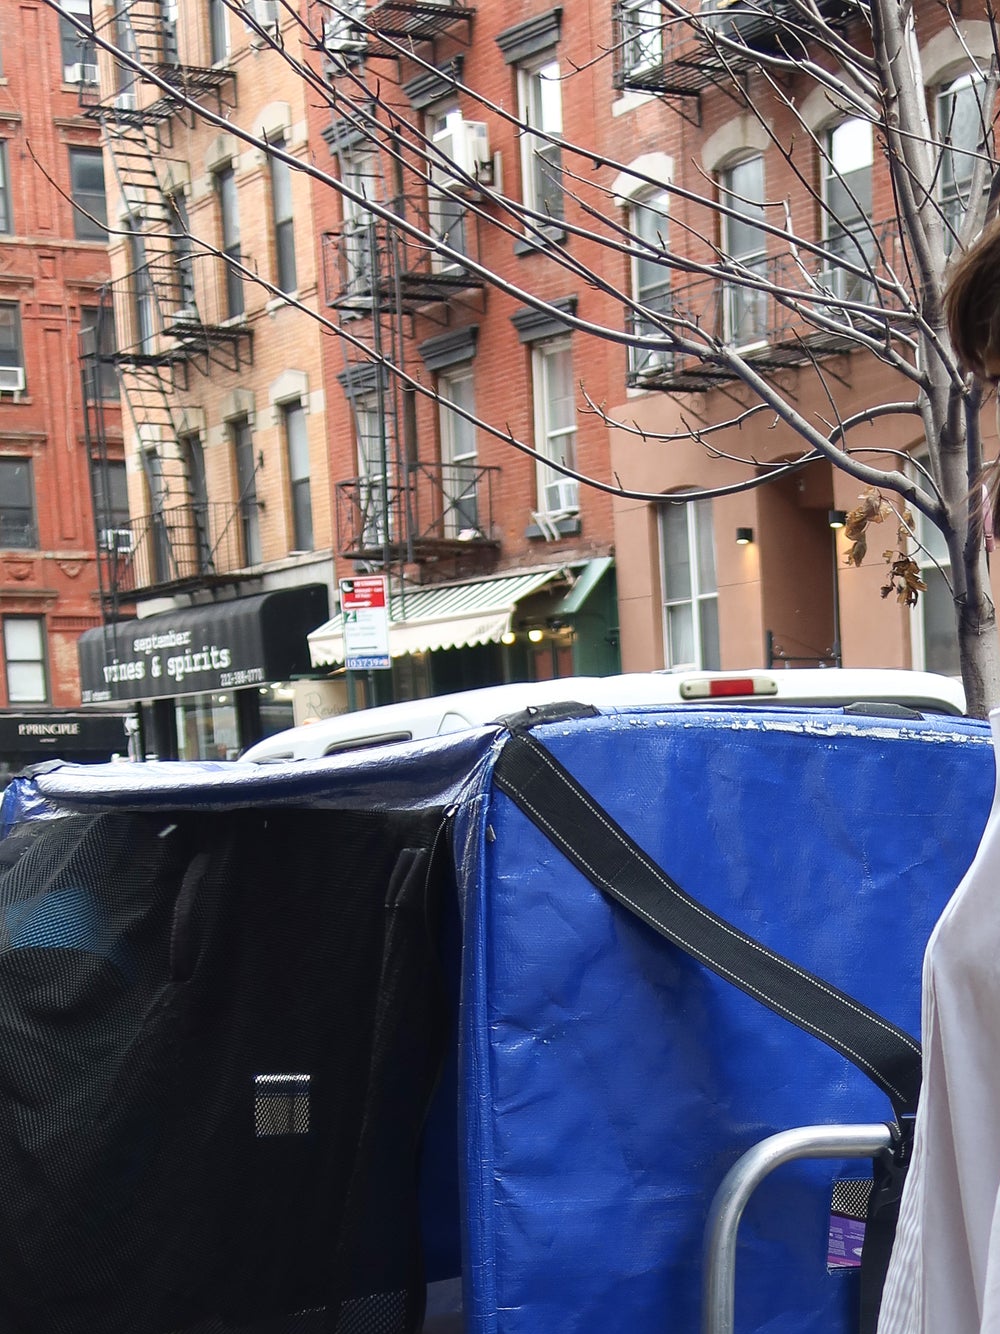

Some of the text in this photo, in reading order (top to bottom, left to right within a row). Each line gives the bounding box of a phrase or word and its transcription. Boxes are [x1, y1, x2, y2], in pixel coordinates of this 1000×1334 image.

[133, 629, 192, 654] september
[151, 655, 162, 678] &
[167, 646, 232, 682] spirits
